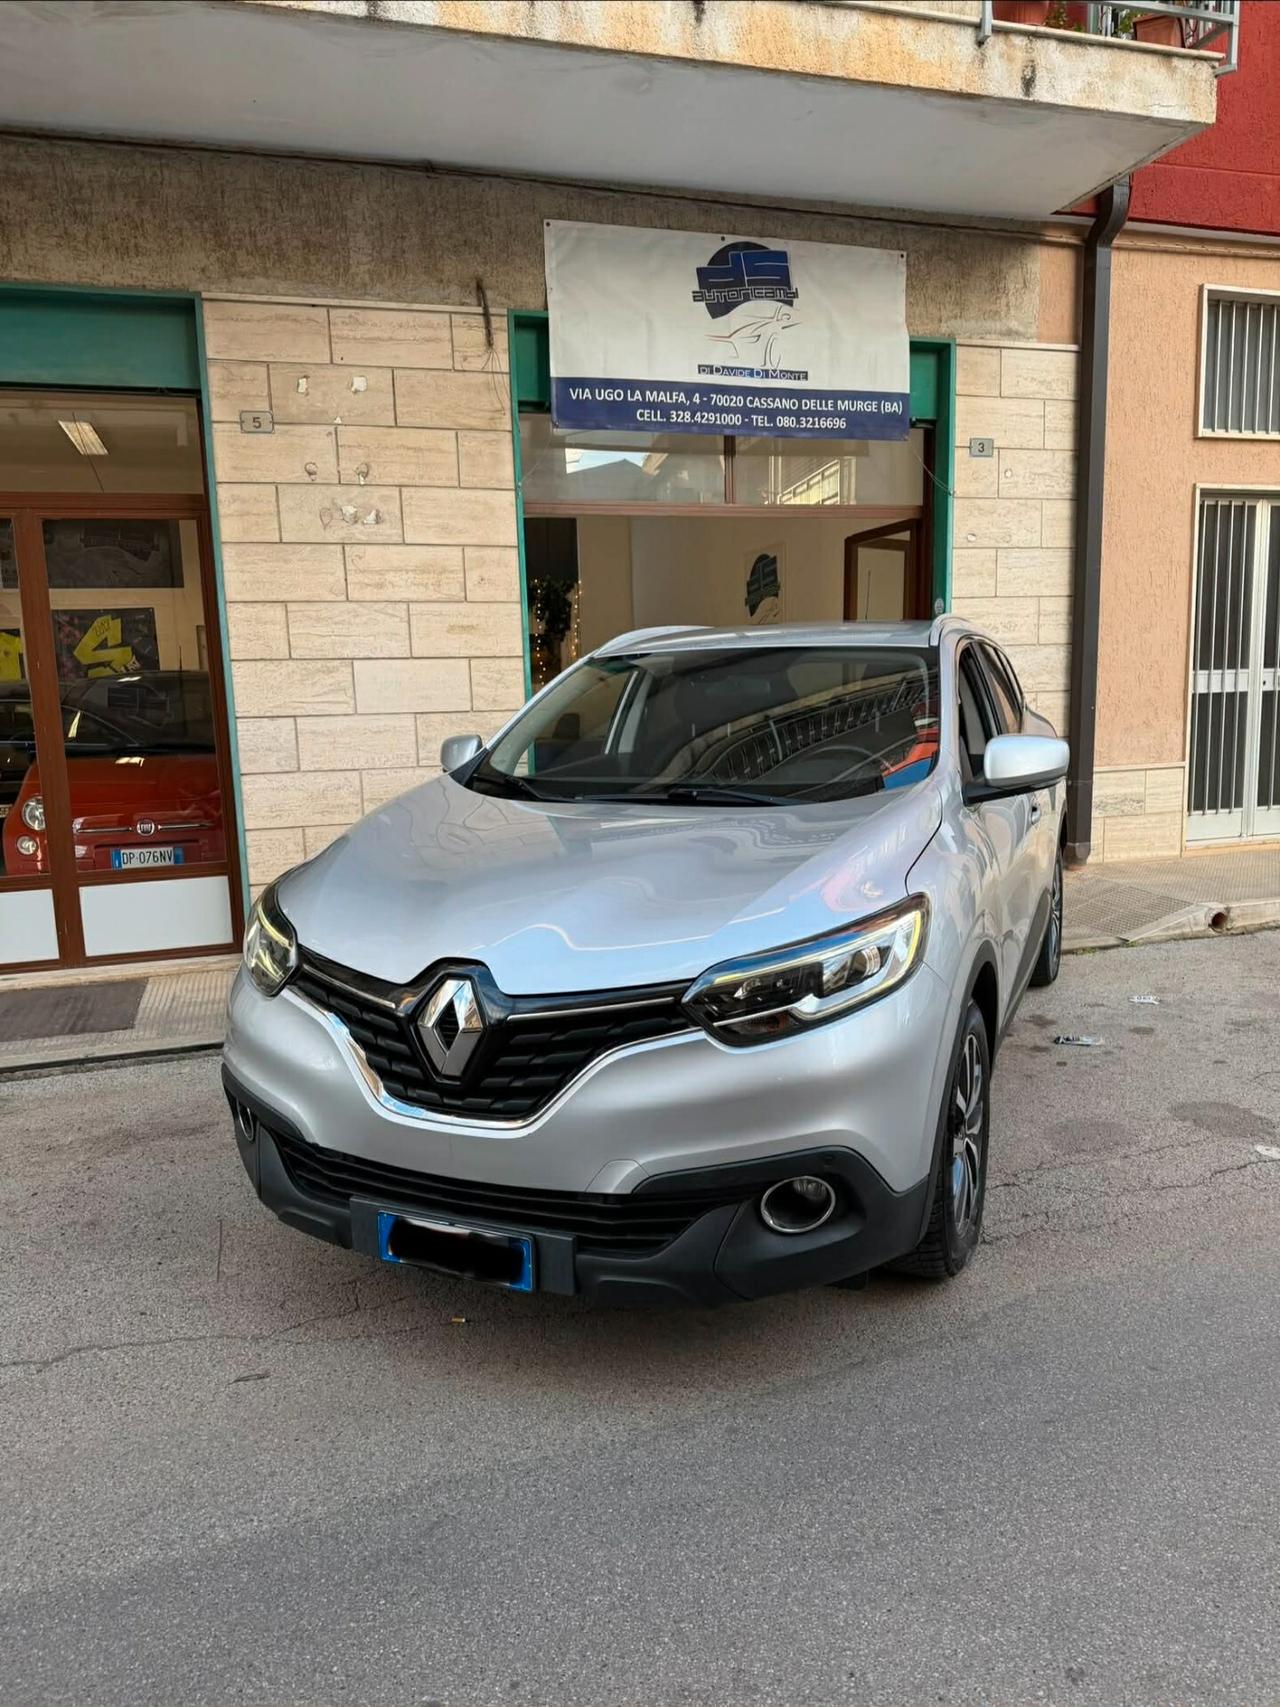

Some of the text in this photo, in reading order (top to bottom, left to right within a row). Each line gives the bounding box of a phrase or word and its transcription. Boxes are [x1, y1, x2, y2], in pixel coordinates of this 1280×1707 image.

[700, 366, 711, 376] DI
[569, 388, 592, 401] VIA
[595, 388, 623, 402] UGO
[627, 390, 642, 402] LA
[645, 390, 690, 406] MALFA,
[693, 393, 700, 405] 4
[710, 394, 744, 407] 70020
[746, 396, 799, 411] CASSANO
[802, 399, 834, 411] DELLE
[837, 400, 878, 413] MURGE
[881, 400, 903, 415] (BA)
[252, 416, 262, 430] 5
[636, 408, 666, 422] CELL.
[669, 410, 742, 426] 328.4291000
[751, 415, 774, 427] TEL.
[776, 416, 847, 429] 080.3216696
[977, 442, 985, 453] 3
[122, 849, 173, 865] DP 076NV
